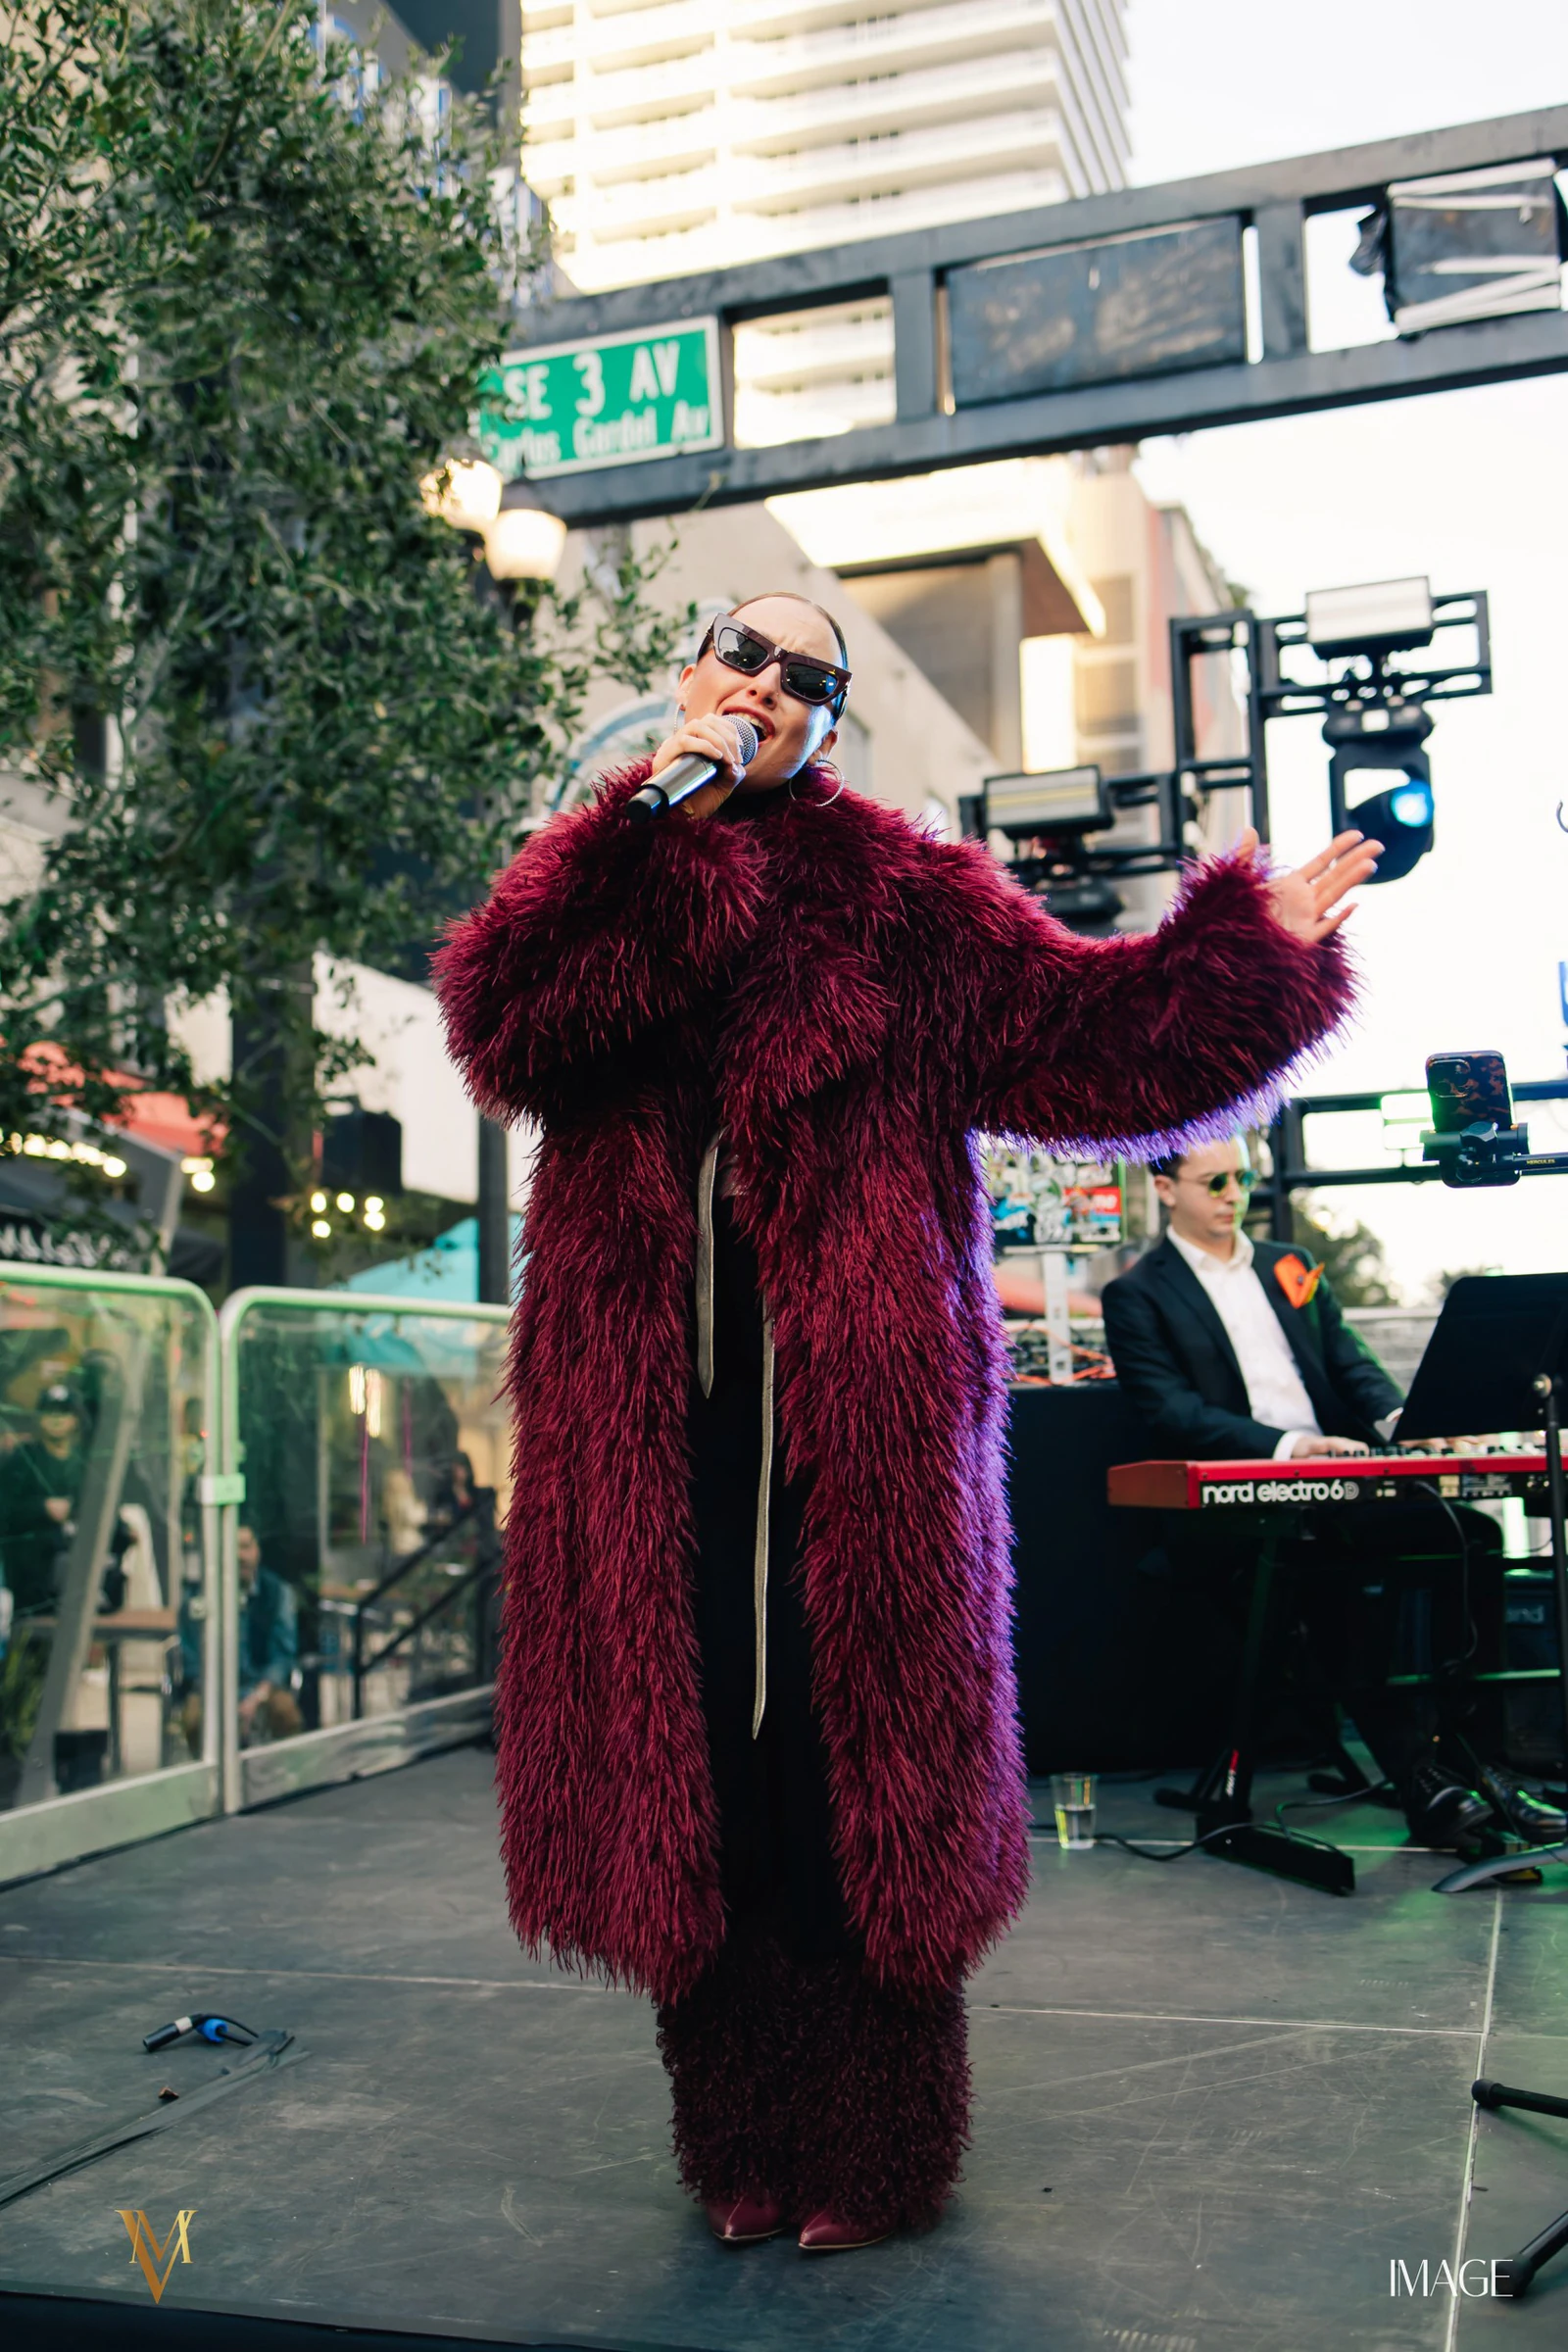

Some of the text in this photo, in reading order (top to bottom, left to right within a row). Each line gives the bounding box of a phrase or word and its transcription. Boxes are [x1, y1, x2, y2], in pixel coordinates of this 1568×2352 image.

[503, 340, 680, 421] SE 3 AV
[1202, 1481, 1254, 1504] nord
